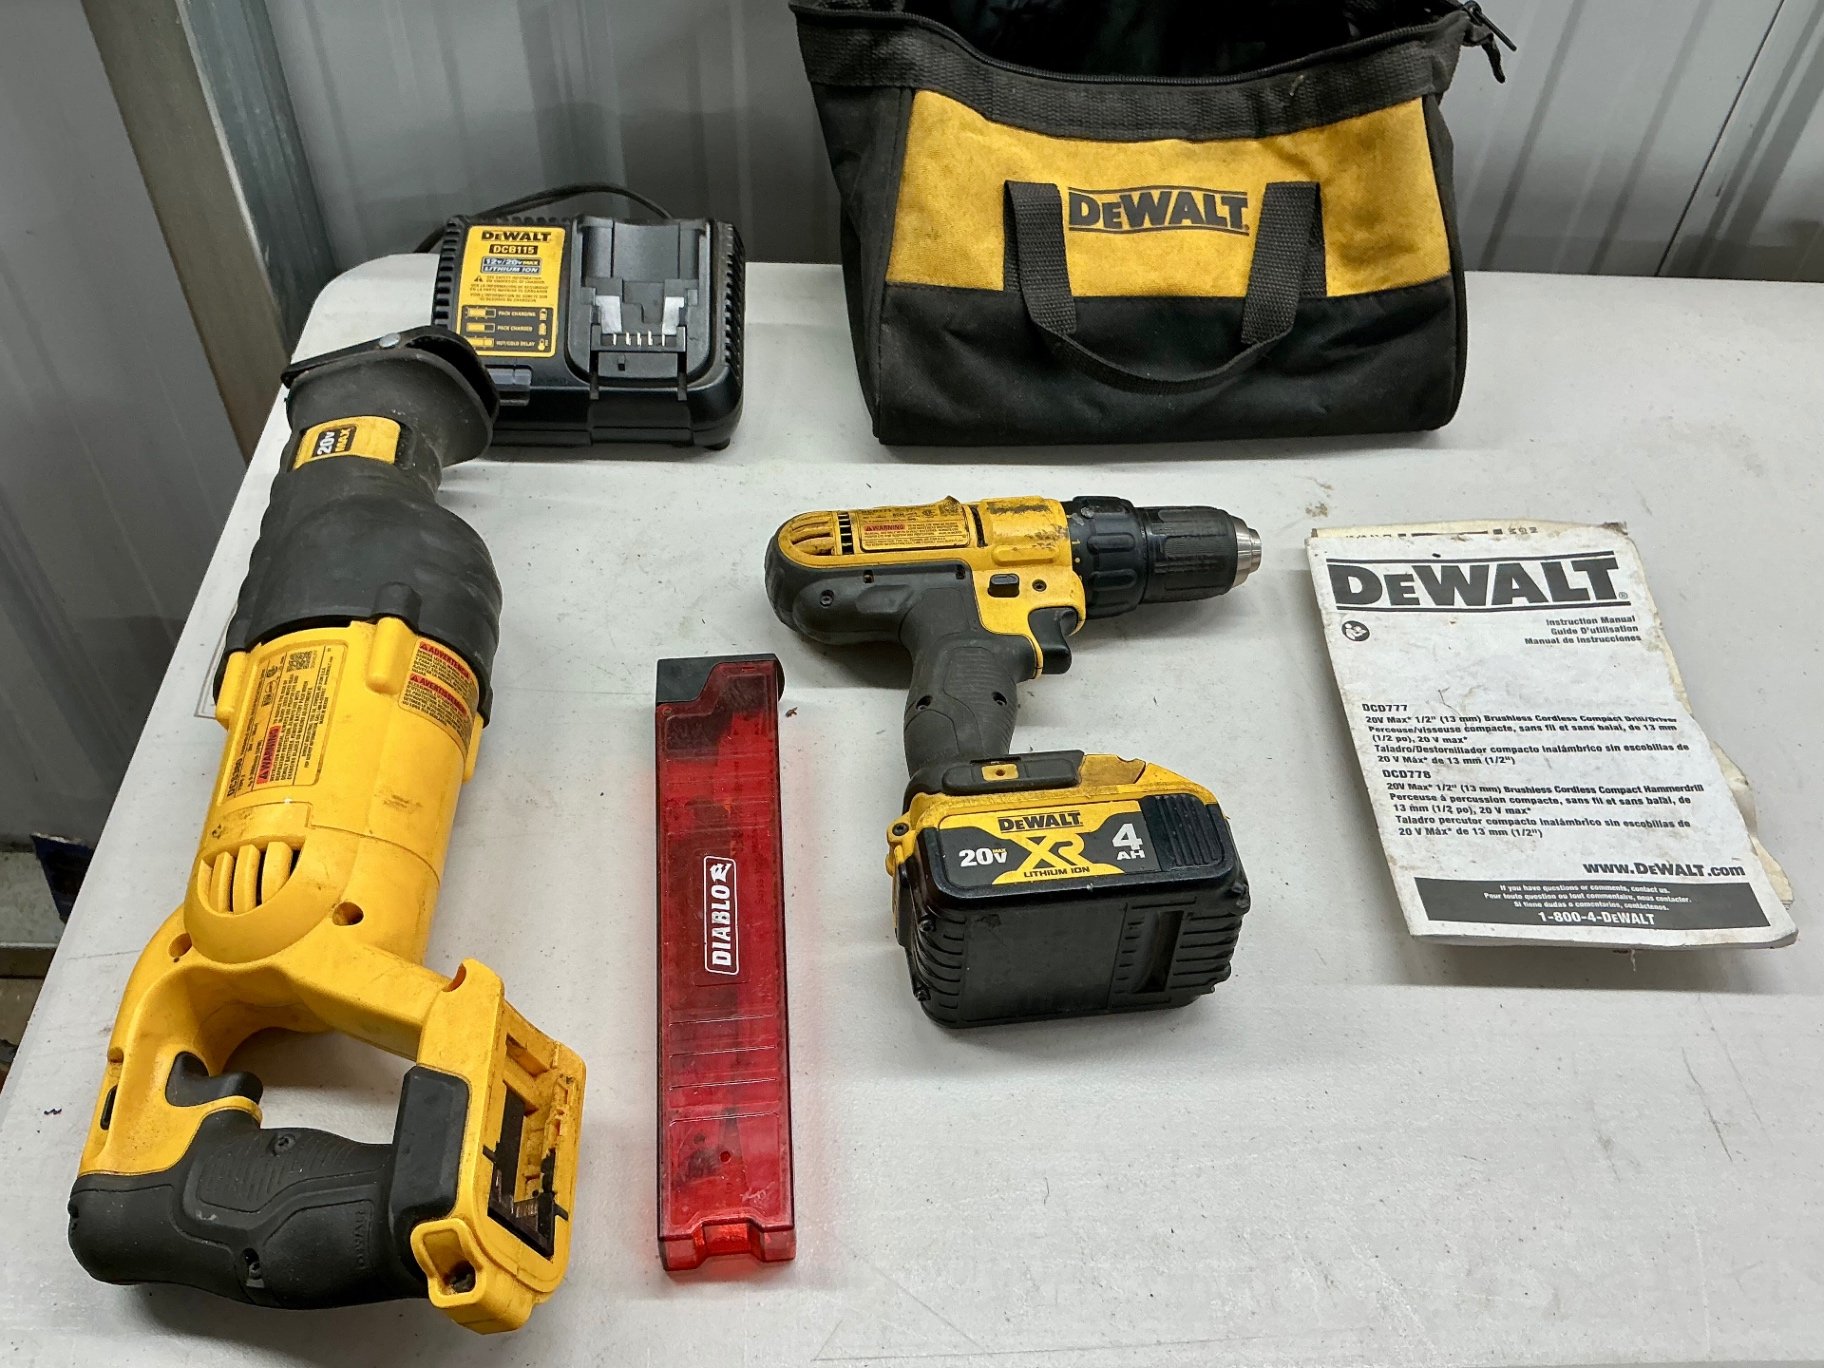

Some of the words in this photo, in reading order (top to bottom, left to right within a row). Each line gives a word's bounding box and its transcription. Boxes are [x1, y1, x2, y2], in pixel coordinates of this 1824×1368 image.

[1069, 190, 1249, 230] DEWALT
[482, 231, 551, 241] DEWALT
[493, 245, 534, 254] DCB115
[317, 431, 335, 455] 20V
[873, 523, 906, 531] WARNING
[1327, 557, 1619, 606] DEWALT
[1546, 616, 1598, 626] Instruction
[1600, 616, 1636, 624] Manual
[1550, 627, 1578, 636] Guide
[1580, 626, 1638, 635] D'utilisation
[1524, 637, 1560, 645] Manual
[1576, 634, 1642, 644] instrucciones
[1362, 704, 1408, 712] DCD777
[1366, 716, 1383, 724] 20V
[1440, 716, 1456, 724] (13
[1459, 716, 1482, 724] mm)
[1484, 714, 1532, 722] Brushless
[1535, 714, 1578, 722] Cordless
[1368, 726, 1461, 734] Perceuse/visseuse
[1464, 725, 1516, 734] compacte,
[1572, 724, 1595, 732] sans
[1598, 724, 1626, 732] balai,
[1372, 734, 1393, 743] (1/2
[1395, 736, 1416, 744] po),
[261, 727, 280, 771] WARNING
[1374, 744, 1486, 754] Taladro/Destornillador
[1490, 746, 1540, 754] compacto
[1542, 744, 1602, 753] inalámbrico
[1606, 744, 1622, 752] sin
[1624, 744, 1674, 752] escobillas
[1378, 755, 1390, 763] 20
[1382, 770, 1432, 779] DCD778
[1387, 782, 1405, 790] 20V
[1460, 784, 1476, 793] (13
[1479, 785, 1501, 794] mm)
[1504, 786, 1552, 794] Brushless
[1554, 786, 1596, 794] Cordless
[1600, 786, 1642, 794] Compact
[1644, 784, 1704, 793] Hammerdrill
[1390, 792, 1437, 801] Perceuse
[1450, 796, 1506, 804] percussion
[1510, 797, 1562, 806] compacte,
[1592, 797, 1603, 805] fil
[1618, 798, 1644, 806] sans
[1646, 796, 1675, 806] balai,
[1678, 796, 1691, 804] de
[1394, 804, 1406, 812] 13
[1432, 804, 1452, 814] (1/2
[1456, 806, 1477, 816] po),
[998, 813, 1081, 832] DEWALT
[1396, 815, 1435, 824] Taladro
[1438, 817, 1482, 826] percutor
[1486, 818, 1536, 826] compacto
[1540, 818, 1602, 826] inalámbrico
[1623, 820, 1675, 828] escobillas
[1678, 820, 1690, 828] de
[1112, 823, 1144, 850] 4
[1399, 828, 1412, 836] 20
[1415, 828, 1422, 836] V
[1456, 828, 1469, 836] de
[1472, 828, 1485, 836] 13
[1012, 831, 1093, 870] XR
[1116, 850, 1146, 861] AH
[958, 848, 1008, 867] 20V
[1024, 868, 1068, 878] LITHIUM
[1071, 866, 1090, 874] ION
[1583, 862, 1746, 877] www.DEWALT.com
[1630, 886, 1658, 894] contact
[1659, 886, 1670, 894] us.
[1538, 911, 1655, 925] 1-800-4-DEWALT
[711, 884, 732, 966] DIABLO
